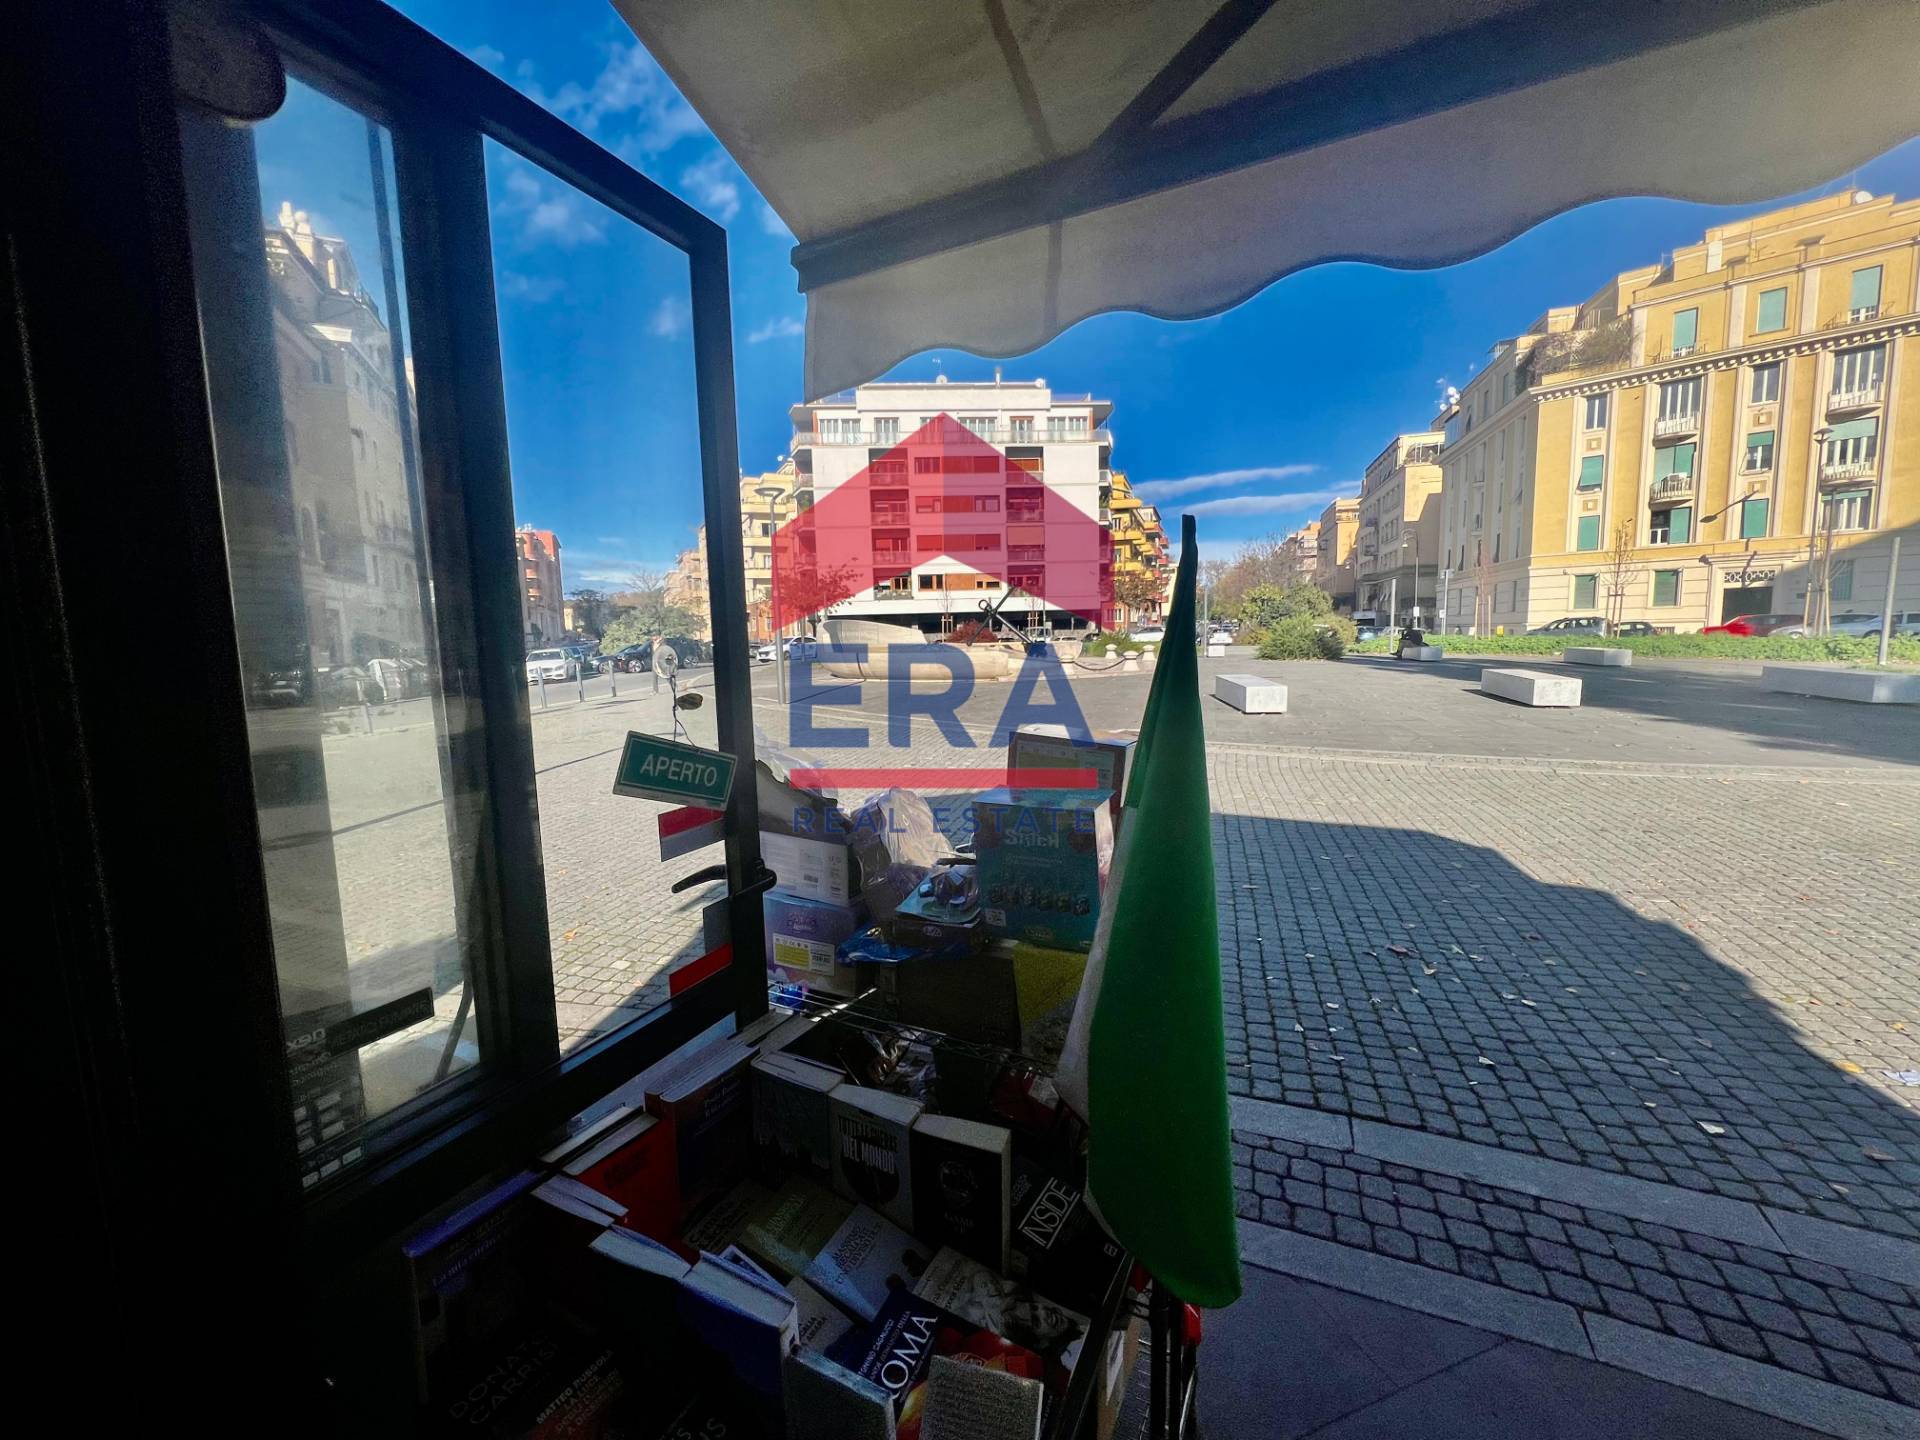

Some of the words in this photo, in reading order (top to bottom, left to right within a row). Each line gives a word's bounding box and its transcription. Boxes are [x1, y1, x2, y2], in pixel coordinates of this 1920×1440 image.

[640, 753, 717, 787] APERTO
[1021, 1182, 1077, 1248] INSIDE
[880, 1315, 939, 1396] OMA
[535, 1386, 573, 1424] MATTEO
